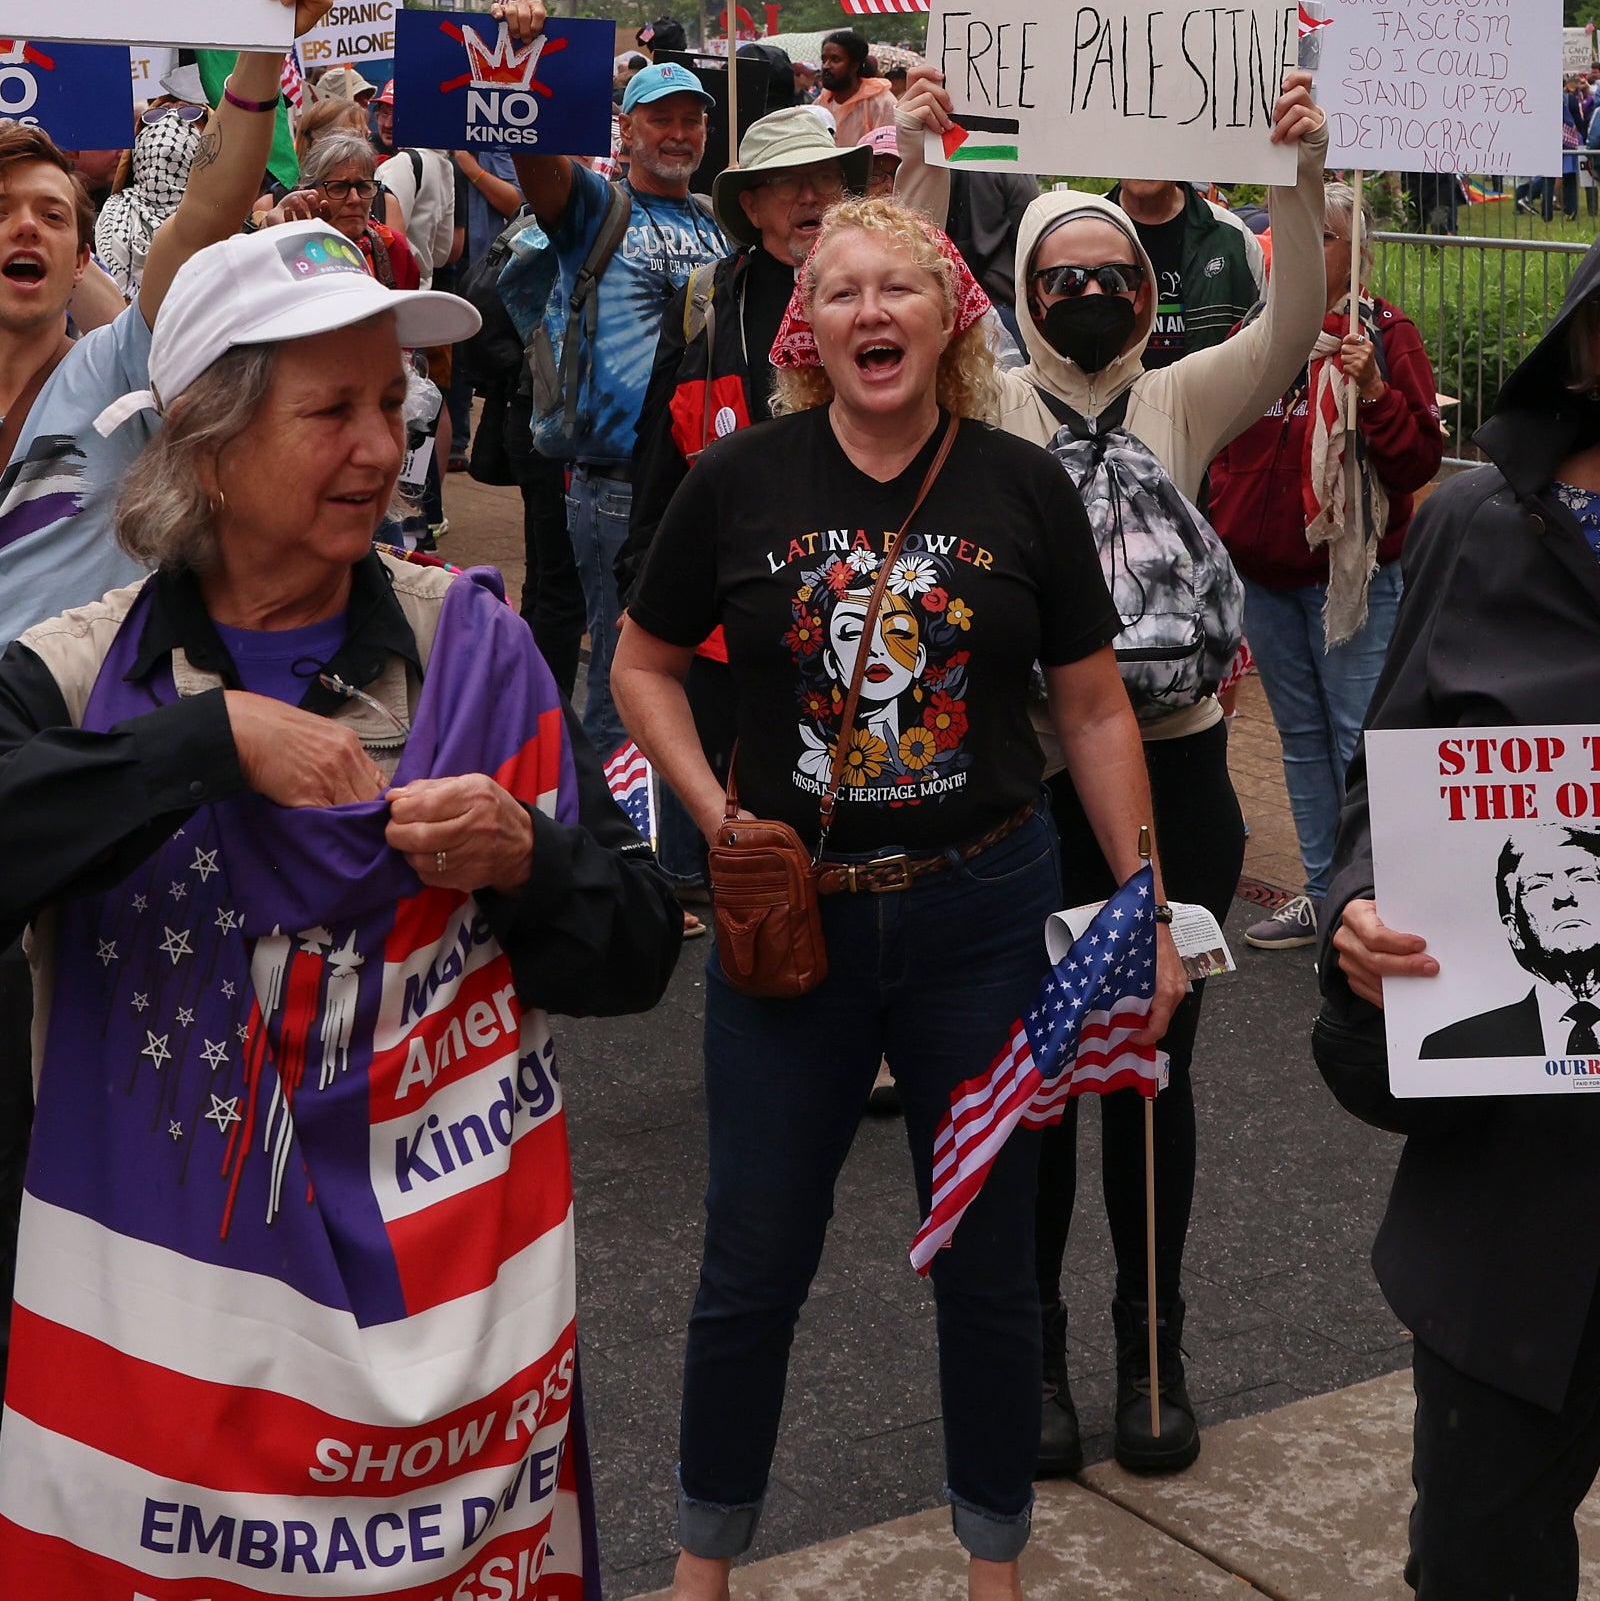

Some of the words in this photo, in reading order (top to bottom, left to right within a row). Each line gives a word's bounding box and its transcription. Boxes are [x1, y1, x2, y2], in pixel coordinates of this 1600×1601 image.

[337, 31, 395, 57] ALONE
[941, 12, 1037, 109] FREE
[1071, 7, 1297, 130] PALESTINE
[1349, 47, 1382, 71] SO
[1393, 49, 1407, 72] I
[1417, 48, 1509, 80] COULD
[466, 90, 539, 127] NO
[1342, 78, 1427, 110] STAND
[1442, 83, 1475, 113] UP
[1480, 85, 1533, 115] FOR
[466, 125, 539, 145] KINGS
[1331, 112, 1500, 152] DEMOCRACY
[1423, 150, 1512, 173] NOW!!!!
[650, 258, 680, 273] DUCH
[766, 529, 872, 575] LATINA
[883, 531, 994, 571] POWER
[1437, 737, 1566, 776] STOP
[792, 771, 845, 801] HISPANC
[848, 784, 916, 802] HERITAGE
[920, 772, 967, 797] MONTH
[1440, 782, 1538, 822] THE
[308, 1411, 496, 1483] SHOW
[505, 1348, 575, 1441] RES
[141, 1497, 445, 1575] EMBRACE
